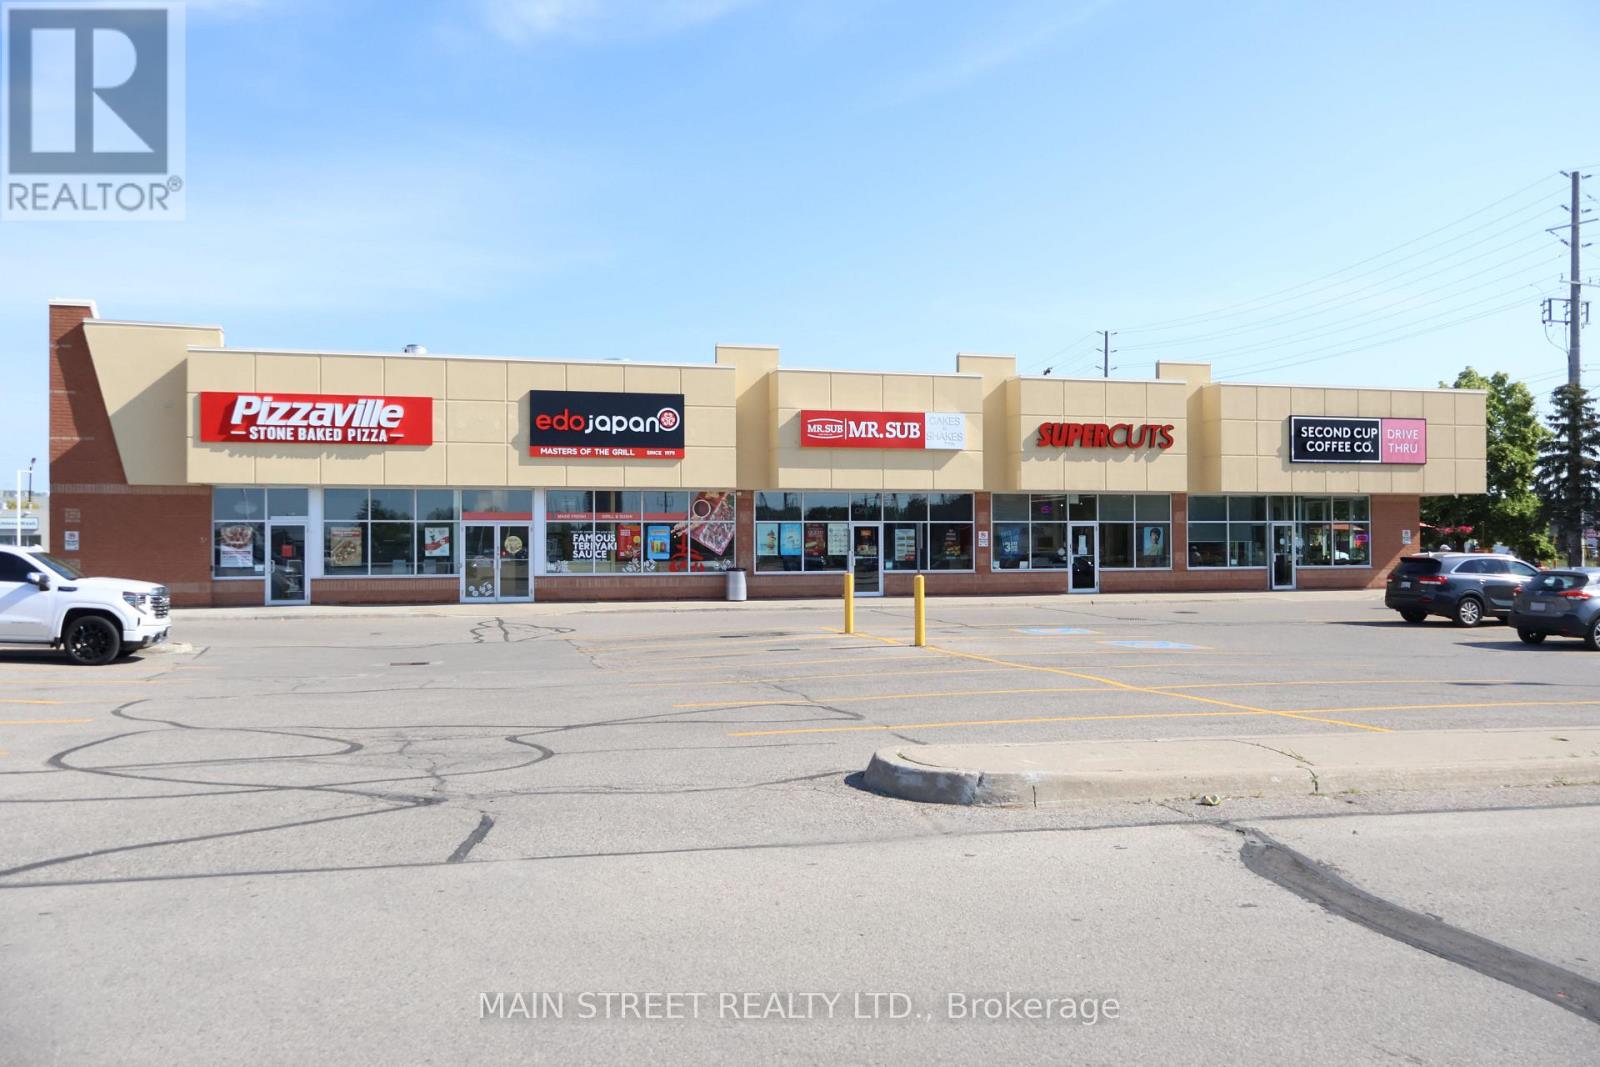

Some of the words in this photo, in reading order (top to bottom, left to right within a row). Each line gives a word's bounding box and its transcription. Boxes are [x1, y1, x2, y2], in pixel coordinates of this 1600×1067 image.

[230, 395, 405, 428] Pizzaville
[928, 416, 961, 426] CAKES
[249, 426, 294, 441] STONE
[298, 427, 342, 442] BAKED
[347, 428, 388, 442] PIZZA
[848, 421, 883, 438] MR.
[885, 421, 921, 439] SUB
[1037, 422, 1175, 449] SUPERCUTS
[1301, 426, 1351, 438] SECOND
[1353, 427, 1378, 439] CUP
[1387, 429, 1419, 440] DRIVE
[926, 431, 964, 441] SHAKES
[540, 447, 577, 455] MASTERS
[594, 448, 609, 456] THE
[1306, 441, 1351, 452] COFFEE
[1353, 441, 1374, 453] CO.
[1388, 443, 1418, 454] THRU
[573, 534, 616, 542] FAMOUS
[573, 542, 617, 550] TERIYAKI
[573, 550, 607, 558] SAUCE
